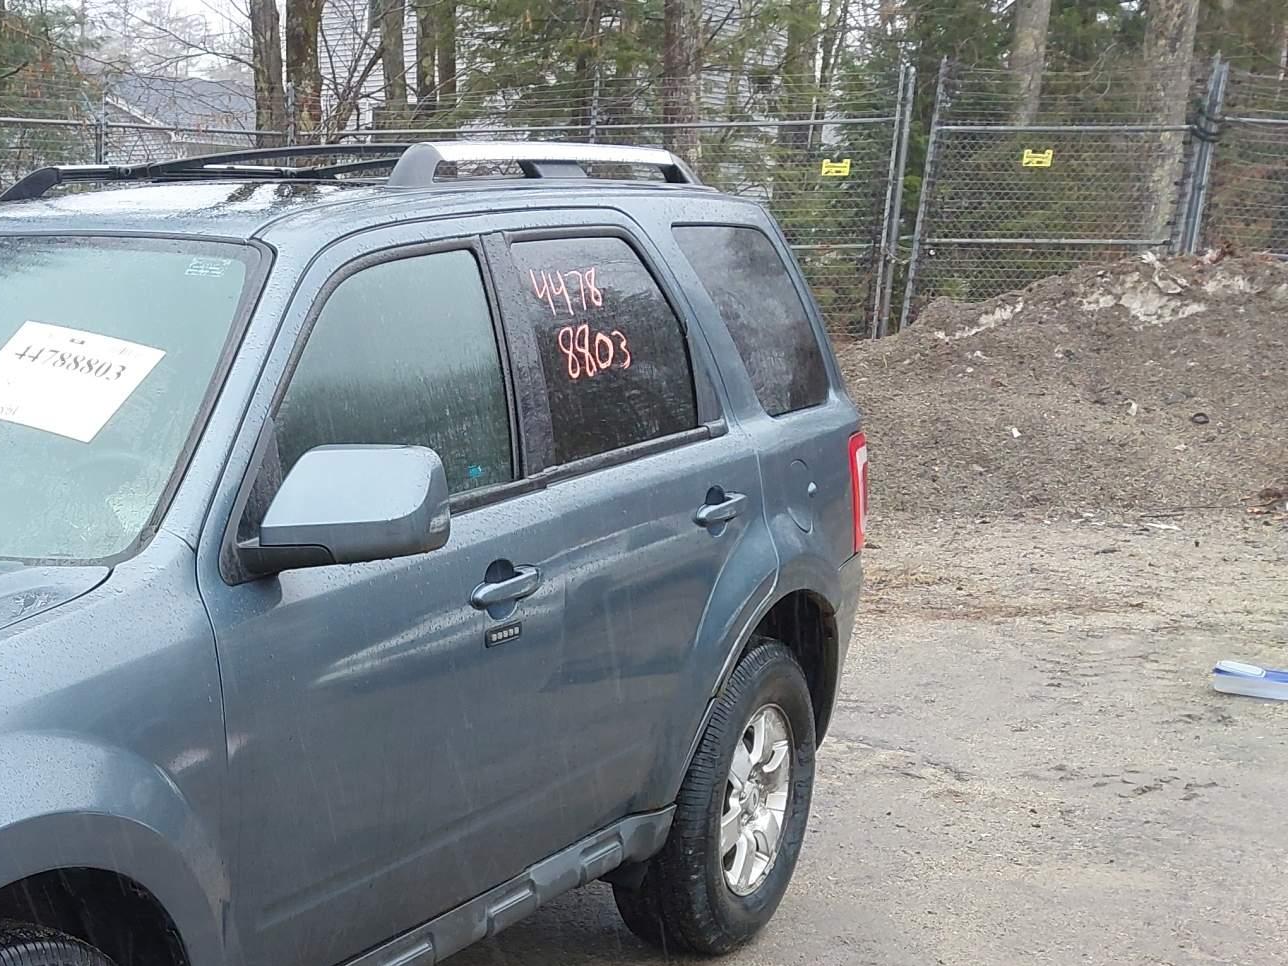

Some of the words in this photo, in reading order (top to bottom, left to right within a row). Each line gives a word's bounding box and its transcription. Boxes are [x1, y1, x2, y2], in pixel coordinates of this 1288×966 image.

[530, 266, 603, 316] 4478
[15, 344, 127, 381] 44788803
[558, 324, 631, 378] 8803
